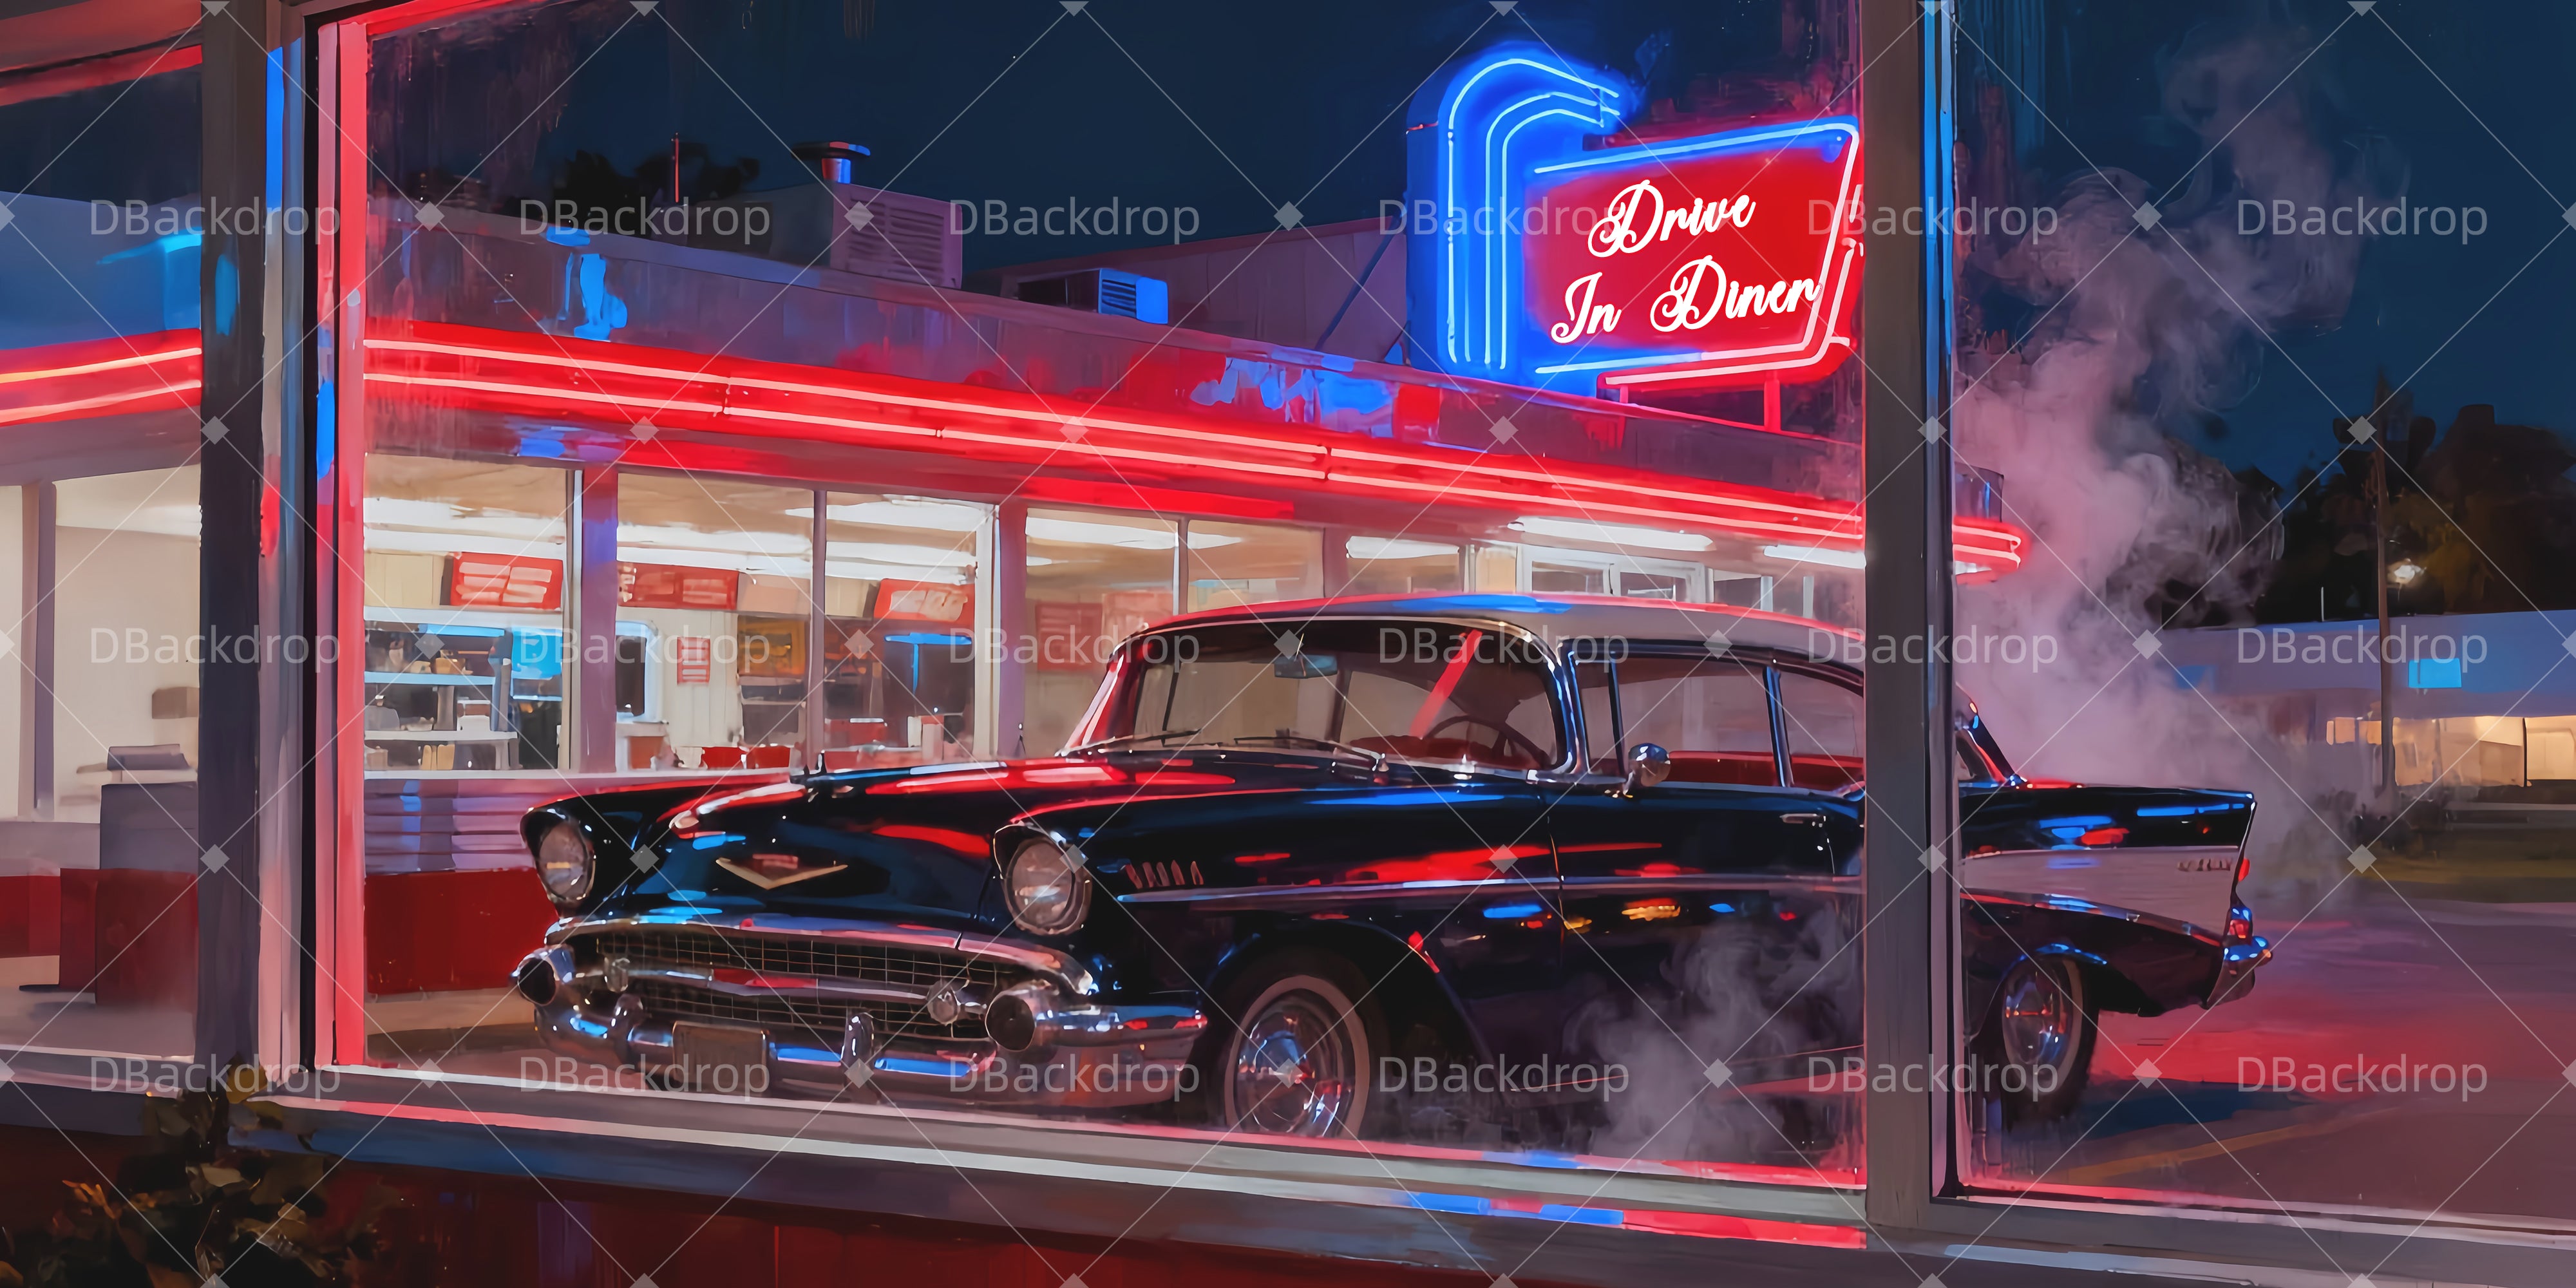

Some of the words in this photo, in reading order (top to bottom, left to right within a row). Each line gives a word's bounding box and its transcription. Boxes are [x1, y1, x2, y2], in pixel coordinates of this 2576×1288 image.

[1587, 179, 1756, 258] Drive
[1551, 272, 1622, 343] In
[1650, 254, 1823, 332] Diner
